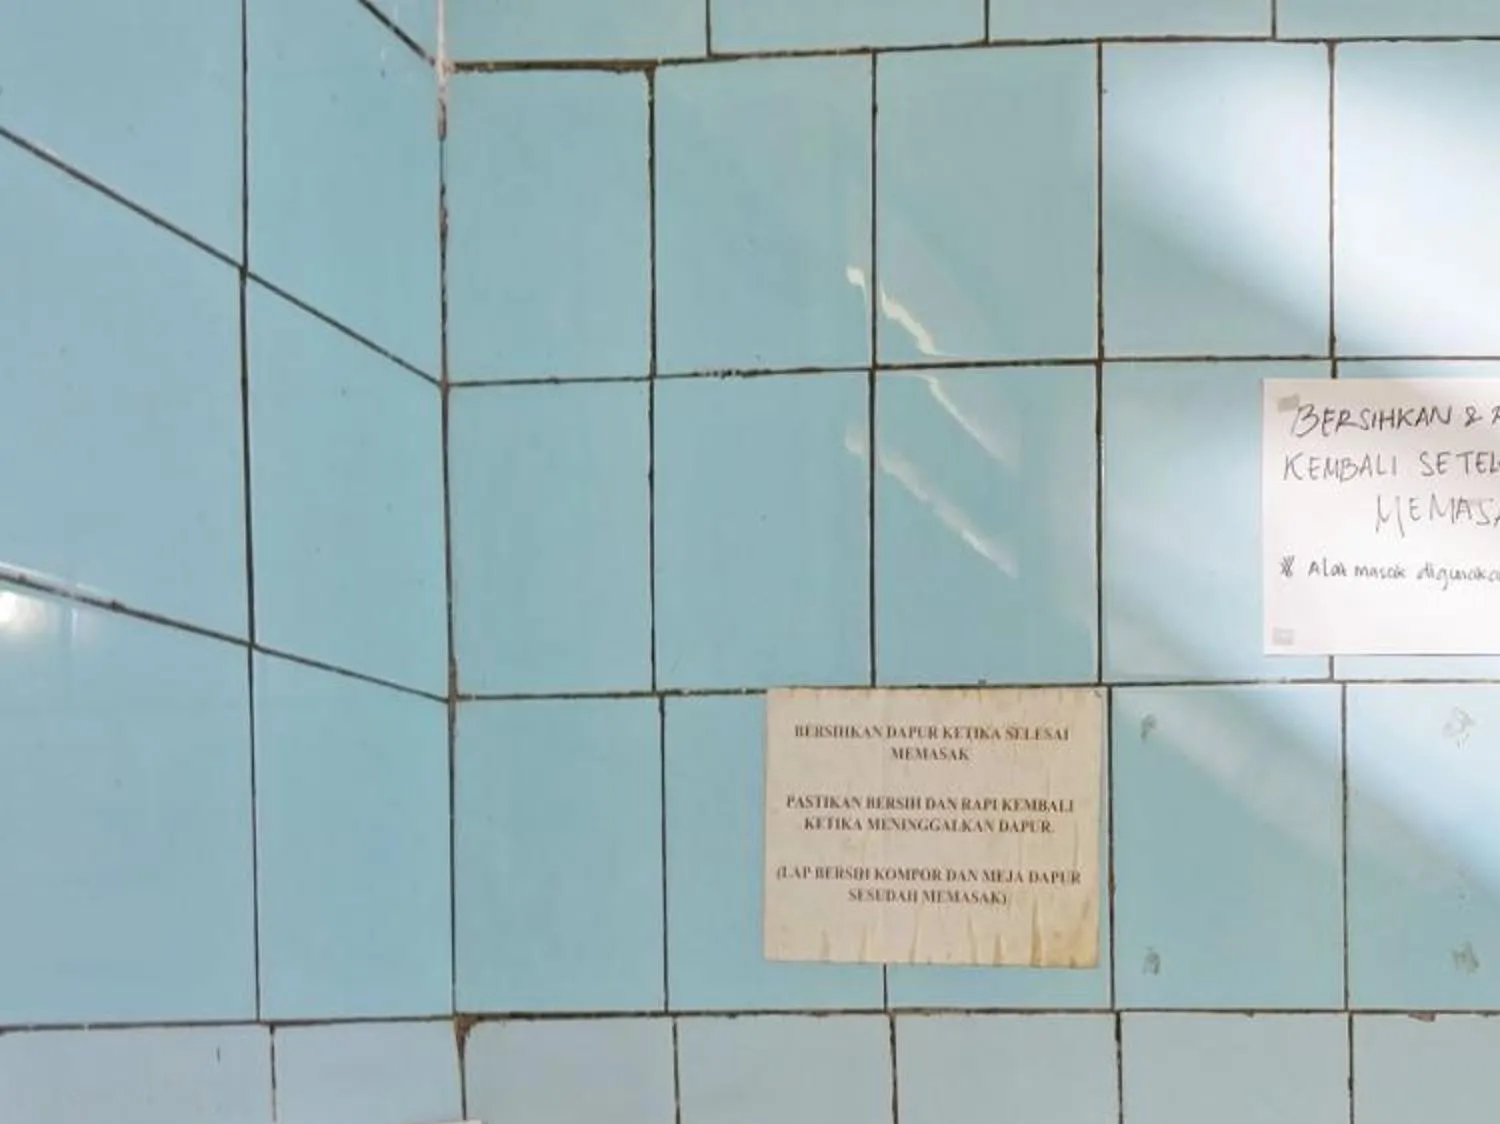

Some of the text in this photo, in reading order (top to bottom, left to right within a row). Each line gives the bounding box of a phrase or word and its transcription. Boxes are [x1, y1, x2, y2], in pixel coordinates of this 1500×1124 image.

[1290, 402, 1451, 437] BERSIHKAN
[1283, 451, 1398, 482] KEMBALI
[795, 725, 1069, 741] BERSIHKAN DAPUR KETIKA SELESAI
[891, 747, 969, 760] MEMASAK
[787, 795, 1074, 812] PASTIKAN BERSIH DAN RAPI KEMBALI
[804, 816, 862, 830] KETIKA
[868, 817, 994, 832] MENINGGALKAN
[776, 865, 1081, 884] (LAP BERSIH KOMPOR DAN MEJA DAPUR
[848, 889, 1007, 905] SESUDAH MEMASAK)
